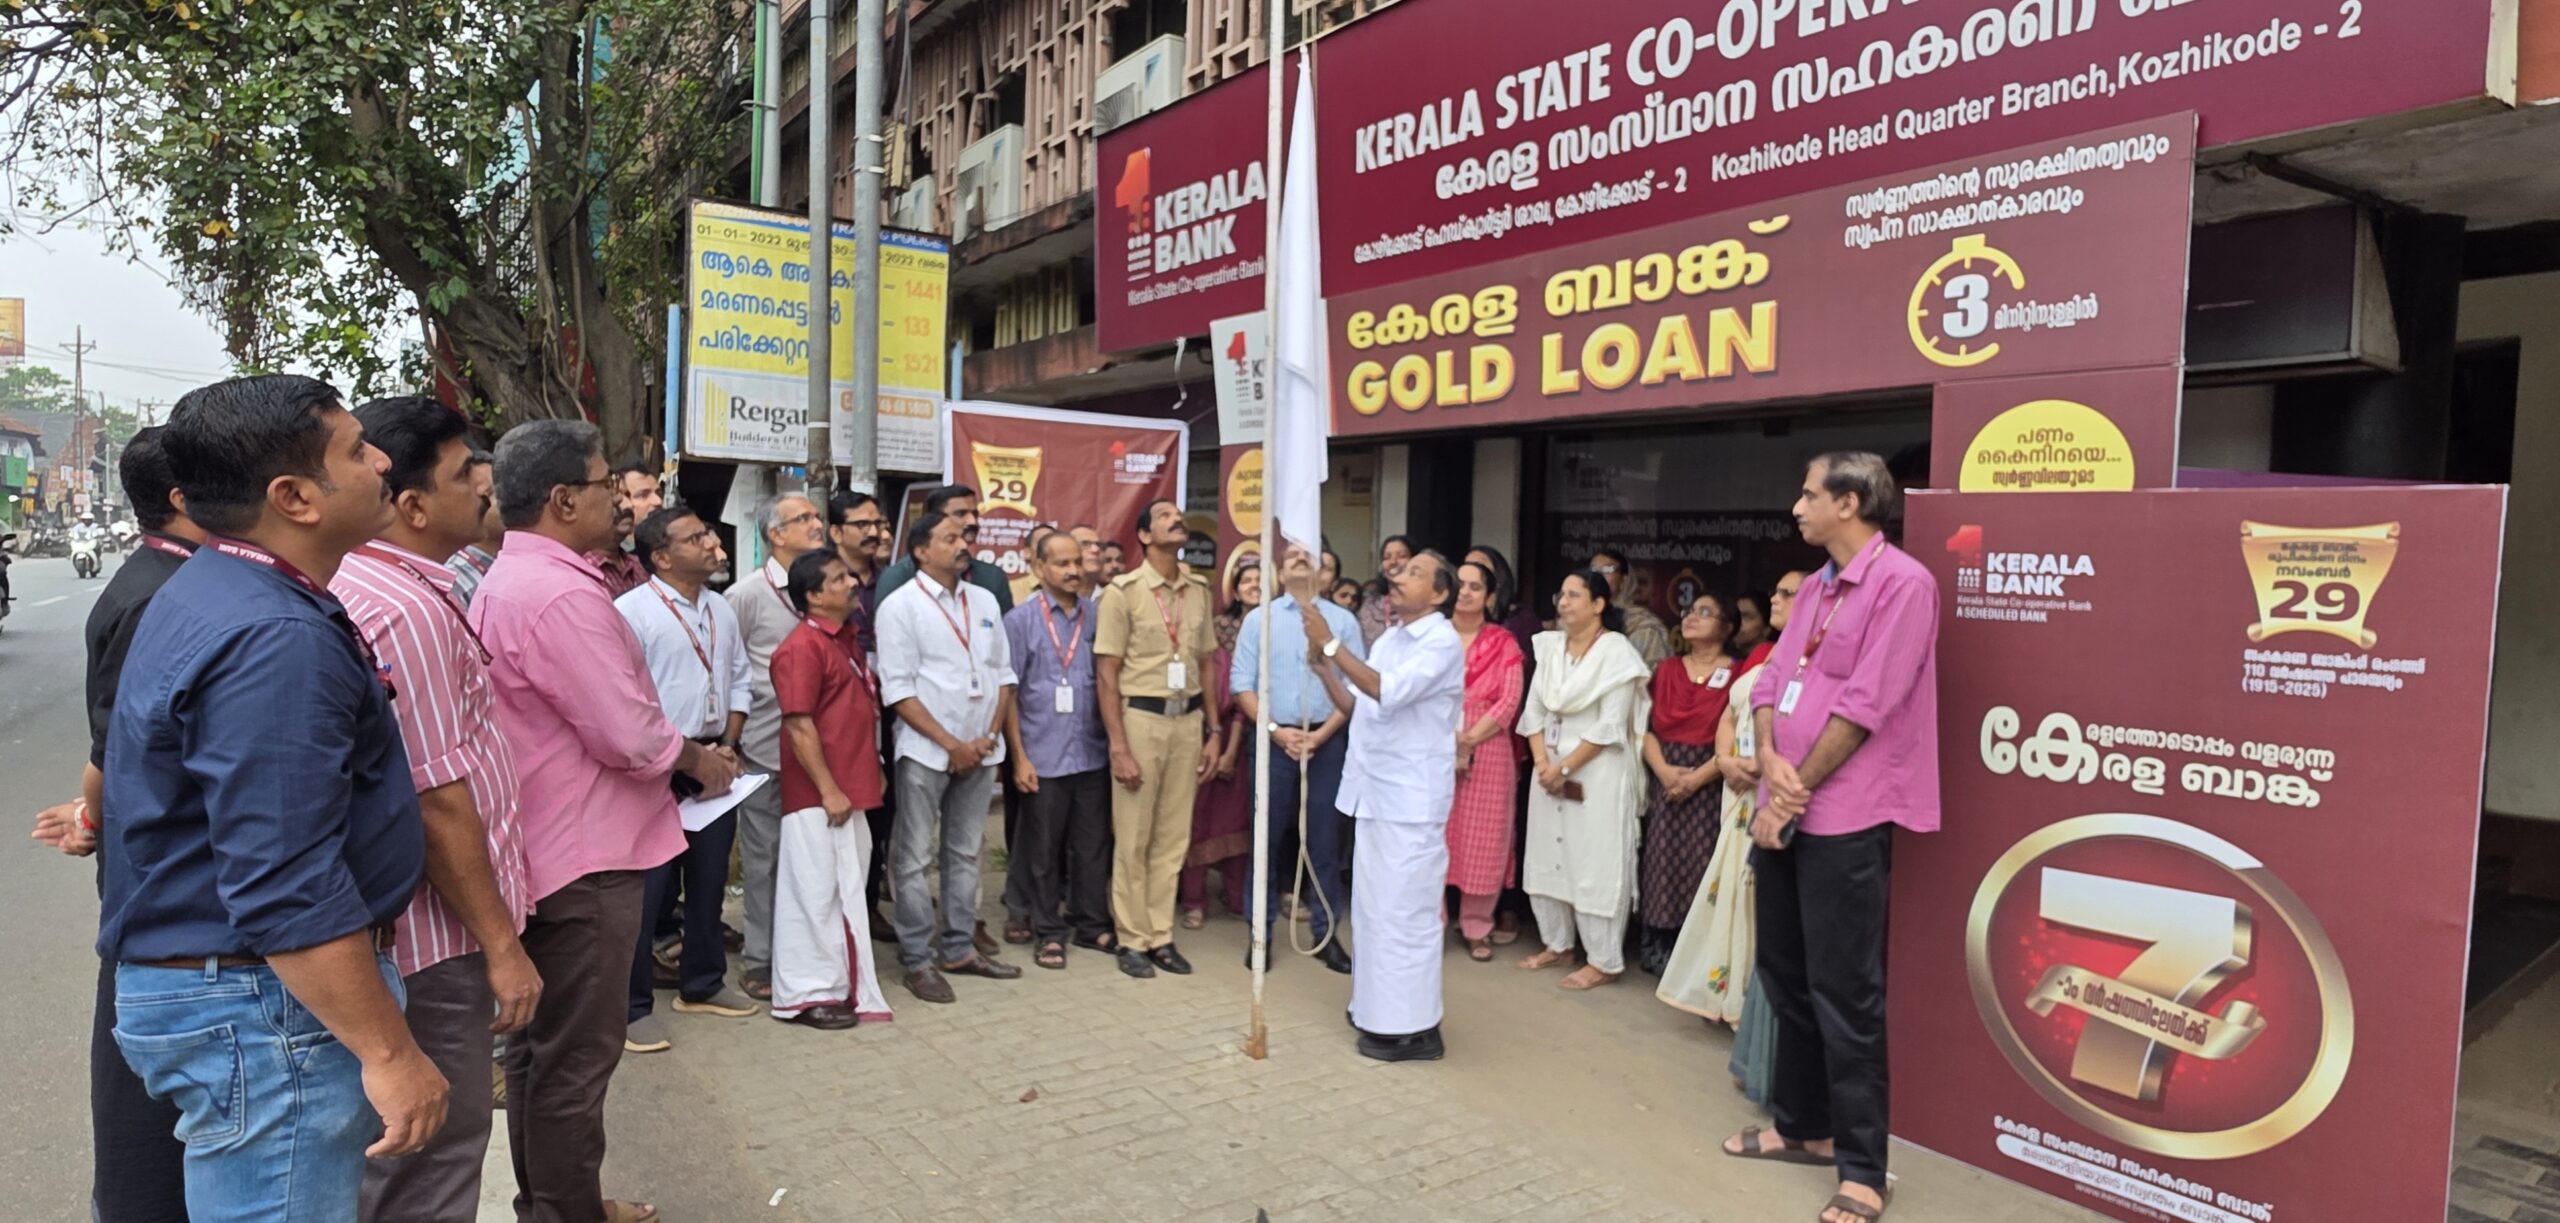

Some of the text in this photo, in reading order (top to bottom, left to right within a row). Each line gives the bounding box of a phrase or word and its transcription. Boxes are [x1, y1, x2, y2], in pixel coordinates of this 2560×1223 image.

[1354, 88, 1485, 174] KERALA
[1496, 43, 1611, 130] STATE
[1436, 141, 1539, 199] കേരള
[1772, 0, 2097, 114] സഹകരണ
[1711, 132, 1823, 183] Kozhikode
[1828, 115, 1889, 158] Head
[1895, 92, 1996, 139] Quarter
[2338, 0, 2362, 39] 2
[1985, 133, 2170, 190] സുരക്ഷിതത്വവും
[1154, 160, 1268, 233] KERALA
[1556, 168, 1656, 220] കോഴിക്കോട്
[1674, 166, 1689, 194] 2
[1844, 185, 2084, 249] സ്വപ്ന സാക്ഷാത്കാരവും
[701, 250, 772, 280] ആകെ
[1154, 214, 1238, 274] BANK
[1347, 214, 1791, 349] കേരള ബാങ്ക്
[903, 316, 931, 338] 133
[1942, 273, 2098, 338] 3 മിനിറ്റിനുള്ളിൽ
[903, 352, 939, 375] 1521
[1347, 343, 1515, 415] GOLD
[1541, 299, 1778, 396] LOAN
[2017, 428, 2075, 445] പണം
[988, 477, 1028, 502] 29
[1986, 573, 2065, 597] BANK
[1987, 552, 2096, 577] KERALA
[2276, 565, 2351, 579] നവംബർ
[1956, 607, 2048, 623] A SCHEDULED BANK
[1957, 595, 1984, 605] Kerala
[1985, 596, 2009, 608] State
[2069, 600, 2092, 612] Bank
[2269, 579, 2361, 622] 29
[2242, 677, 2327, 699] (1915-2025)
[2244, 663, 2266, 678] 110
[2241, 740, 2335, 772] വളരുന്ന
[2181, 760, 2333, 809] ബാങ്ക്
[2039, 866, 2252, 1101] 7
[1994, 1115, 2041, 1144] കേരള
[2120, 1158, 2213, 1203] സഹകരണ
